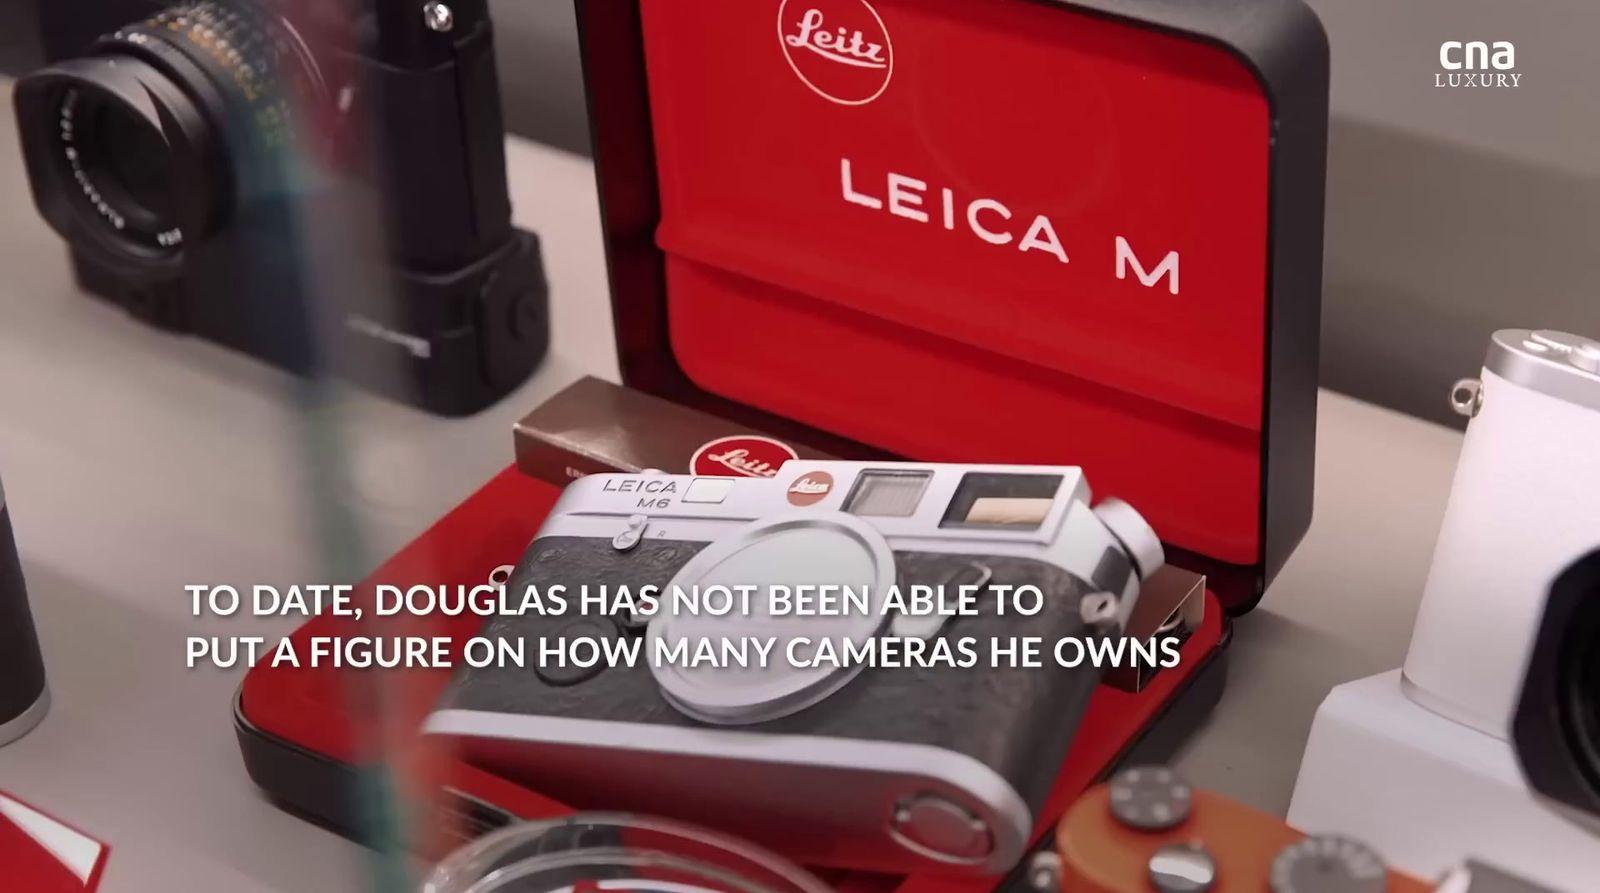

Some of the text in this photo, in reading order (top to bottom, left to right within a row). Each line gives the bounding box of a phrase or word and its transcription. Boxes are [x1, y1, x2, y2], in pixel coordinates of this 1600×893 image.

[786, 8, 886, 69] Leitz
[840, 158, 1180, 295] LEICA M
[602, 479, 677, 494] LEICA
[636, 497, 671, 509] M6
